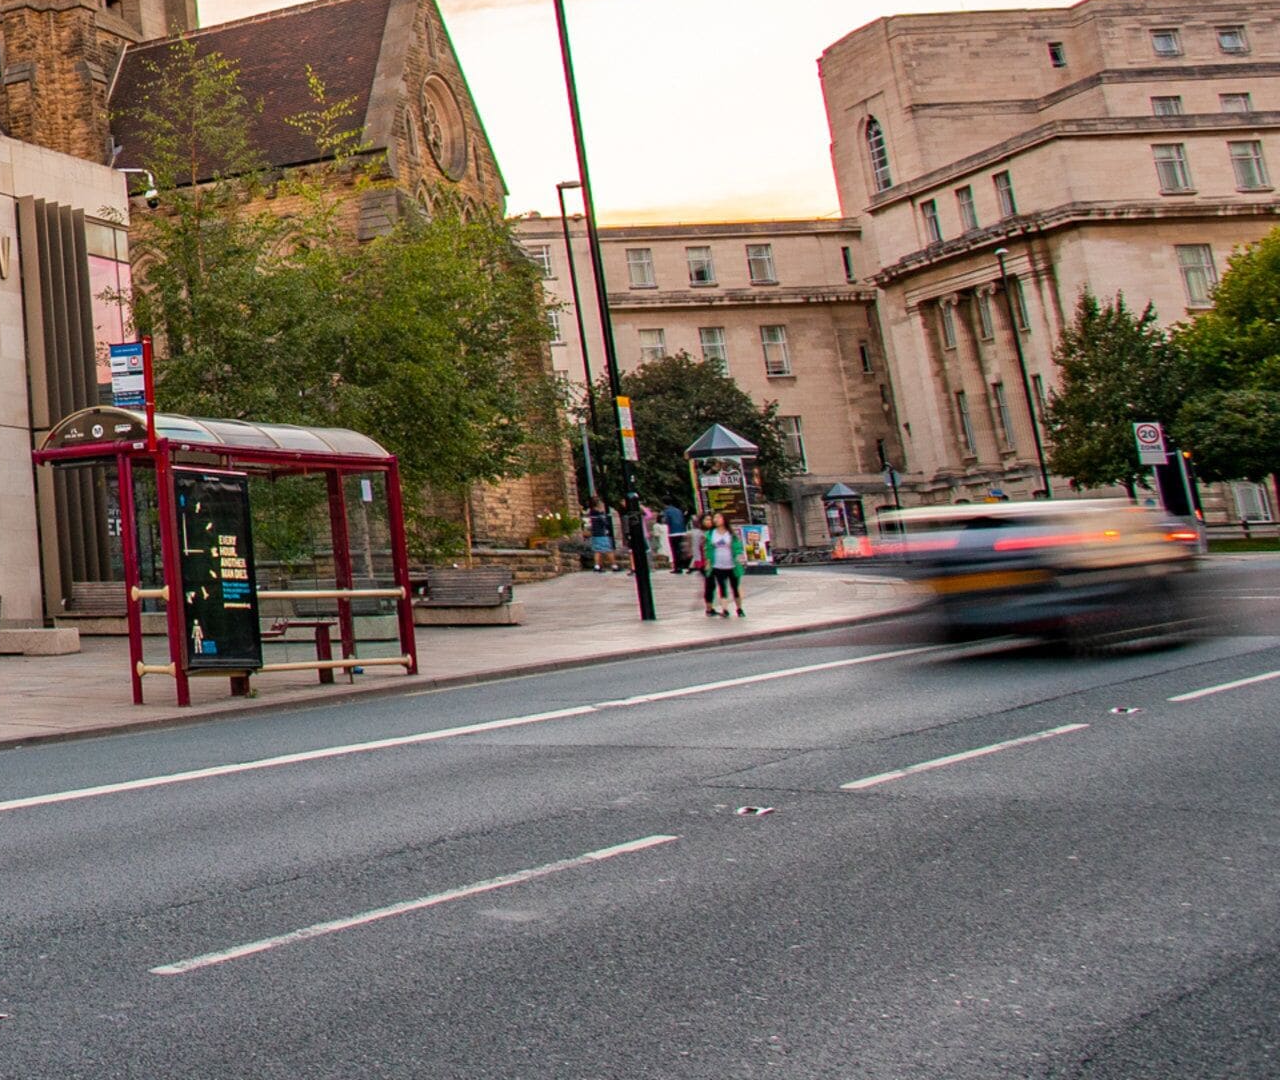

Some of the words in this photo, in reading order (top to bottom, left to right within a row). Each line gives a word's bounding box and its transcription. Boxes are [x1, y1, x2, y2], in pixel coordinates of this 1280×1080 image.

[1140, 429, 1156, 439] 20
[218, 535, 237, 546] EVERY
[221, 557, 247, 568] ANOTHER
